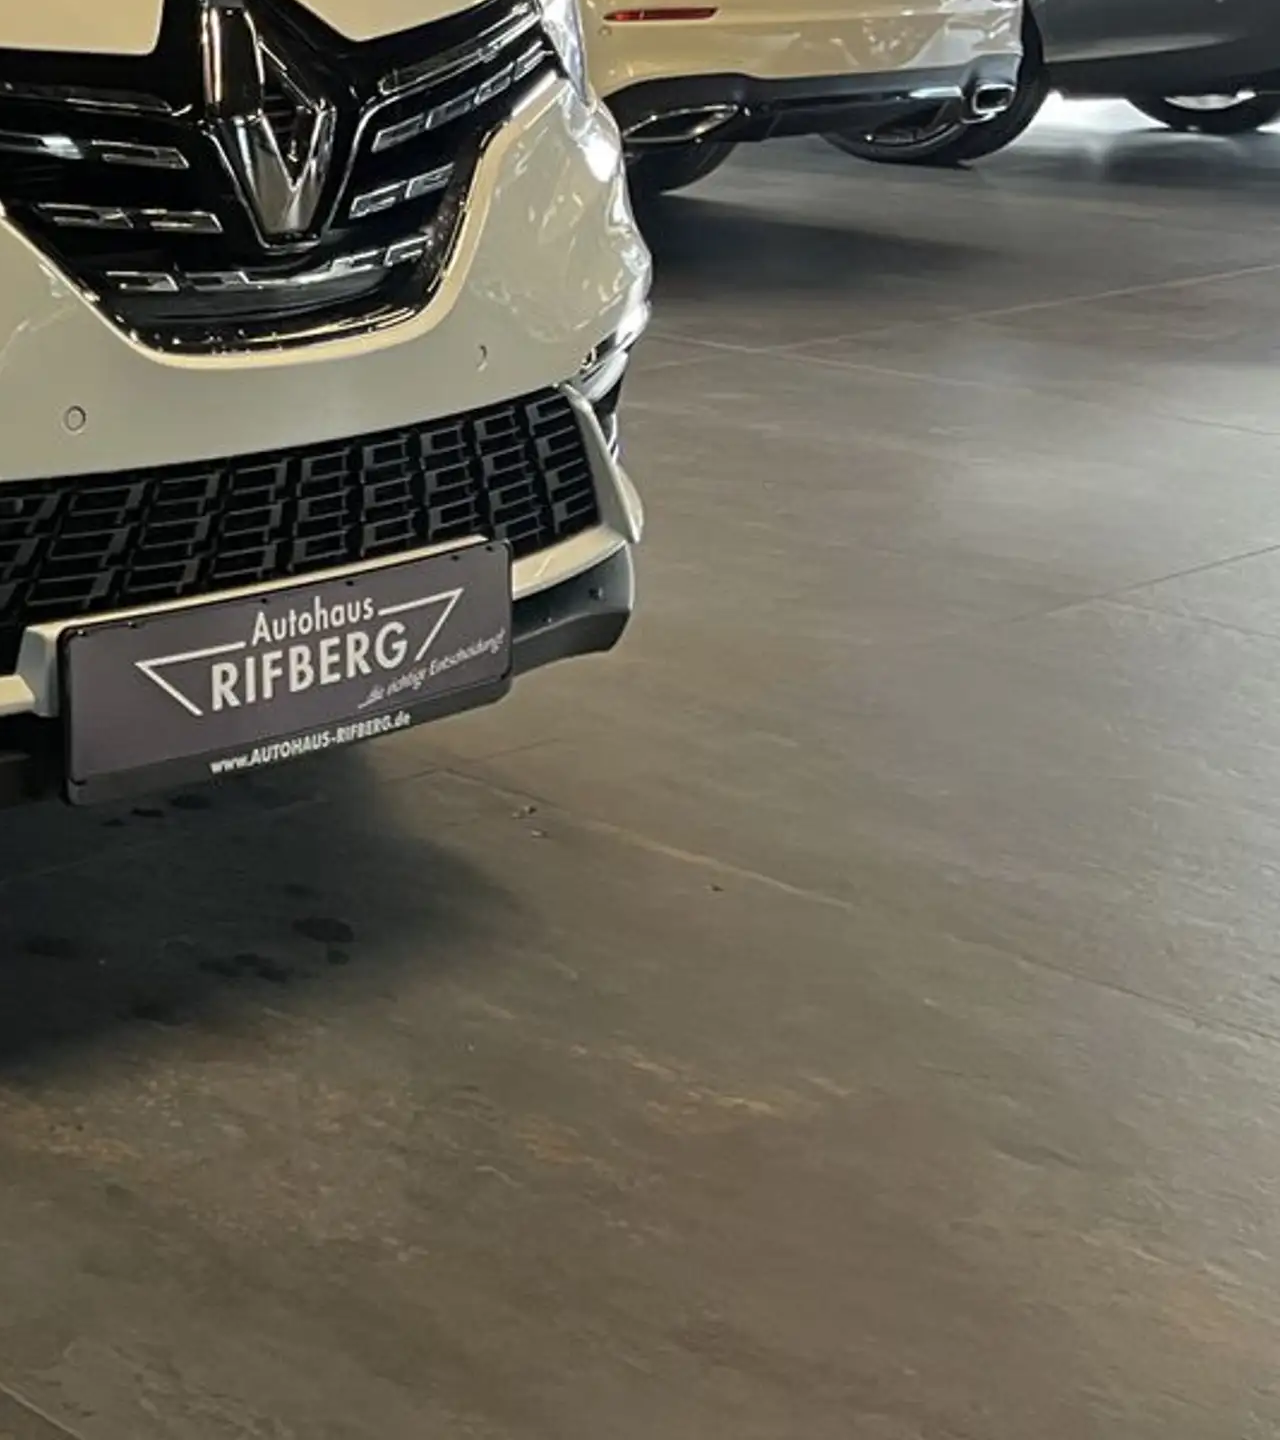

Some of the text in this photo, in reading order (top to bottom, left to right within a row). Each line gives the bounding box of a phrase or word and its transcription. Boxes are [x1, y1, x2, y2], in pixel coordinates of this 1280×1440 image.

[252, 595, 374, 646] Autohaus
[210, 621, 408, 711] RIFBERG
[209, 711, 411, 774] www.AUTOHAUS-RIFBERG.de
